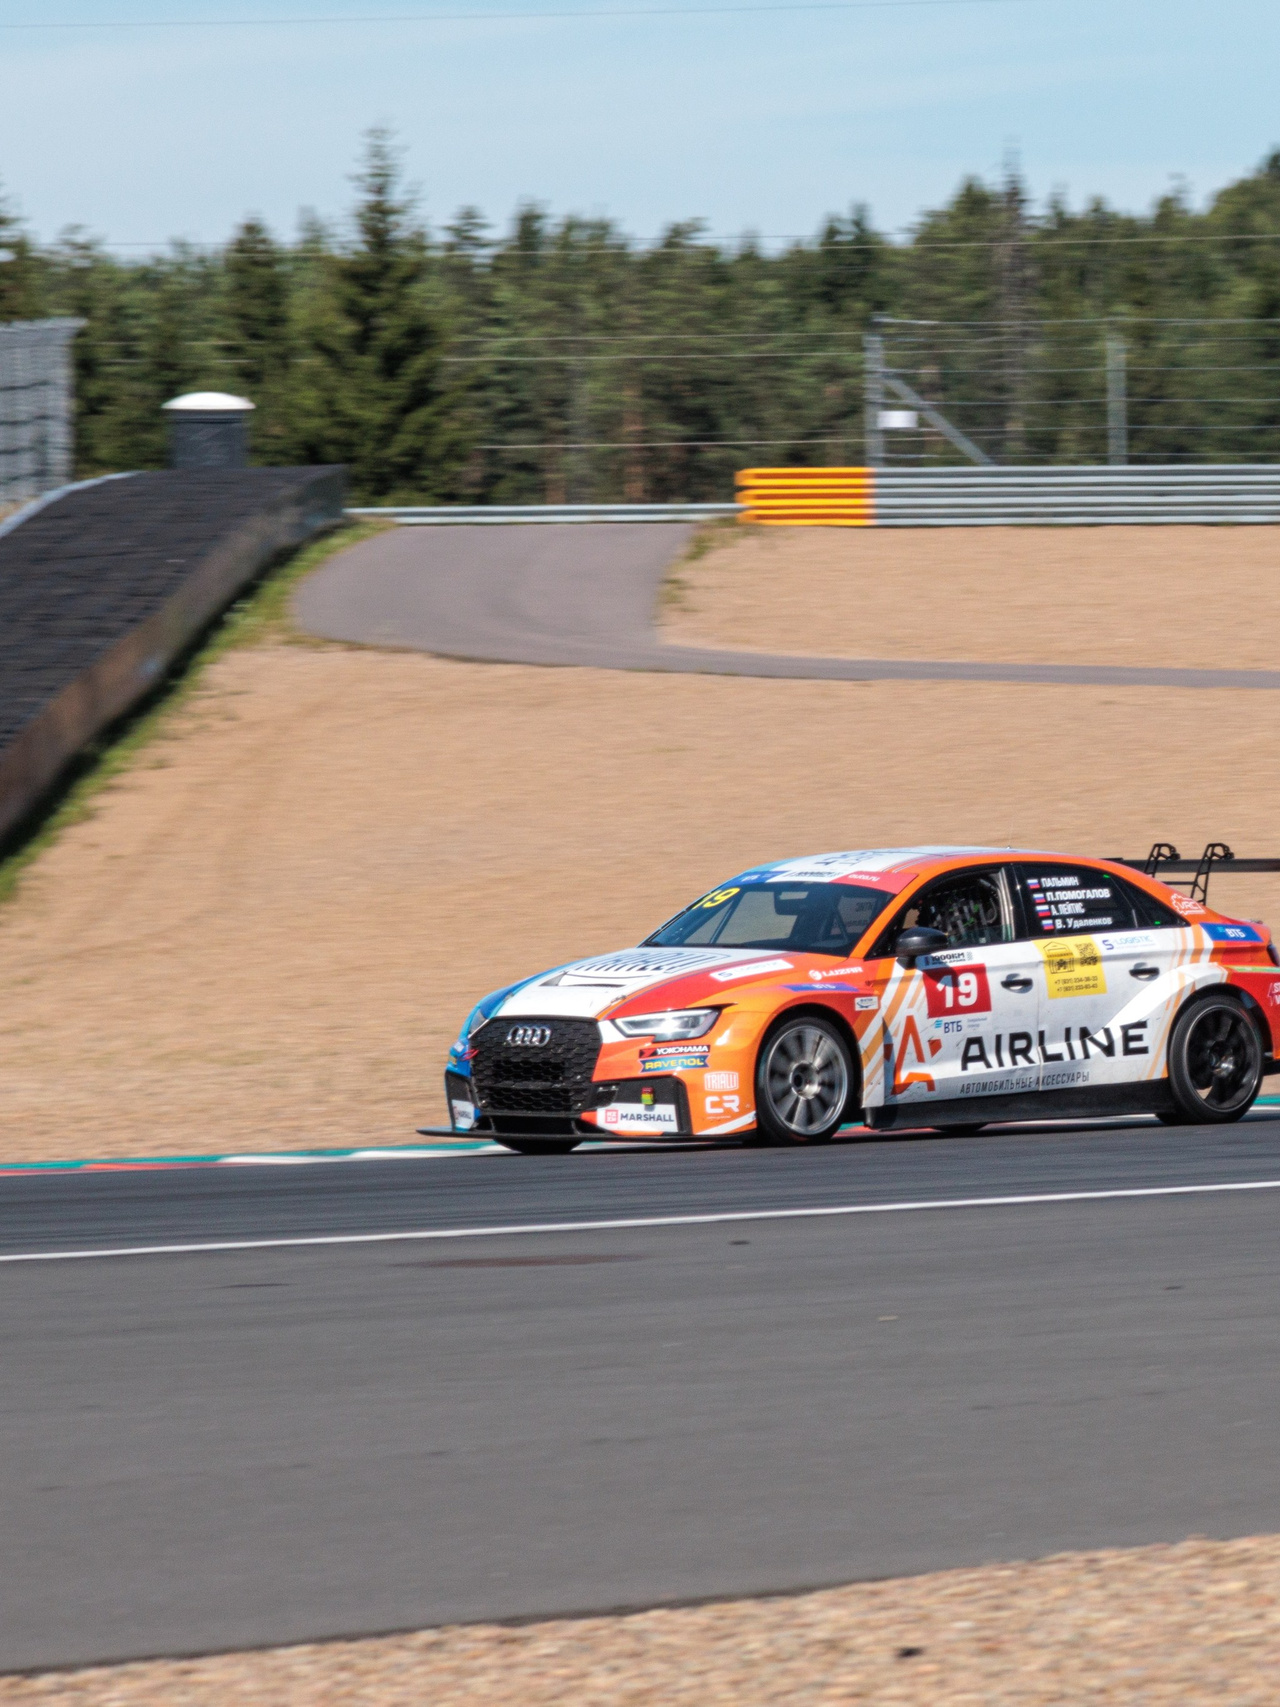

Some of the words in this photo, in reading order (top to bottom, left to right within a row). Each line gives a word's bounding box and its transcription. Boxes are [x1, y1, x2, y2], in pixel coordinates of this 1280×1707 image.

[1041, 876, 1080, 888] ПАЛЬМИН
[691, 887, 741, 910] 19
[1045, 888, 1111, 901] П.ПОМОГАЛОВ
[1050, 902, 1086, 916] А.ЛЕЙТИС
[1067, 917, 1113, 929] Удаленков
[822, 966, 864, 978] LUZAR
[936, 972, 979, 1009] 19
[943, 1020, 963, 1034] ВТБ
[656, 1045, 709, 1056] YOKOHAMA
[960, 1020, 1150, 1072] AIRLINE
[644, 1058, 705, 1070] RAVENOL
[706, 1073, 738, 1091] TRIALLI
[959, 1077, 1033, 1095] АВТОМОБИЛЬНЫЕ
[1035, 1071, 1090, 1091] АКСЕССУАРЫ
[705, 1094, 740, 1114] CR
[620, 1112, 675, 1123] MARSHALL
